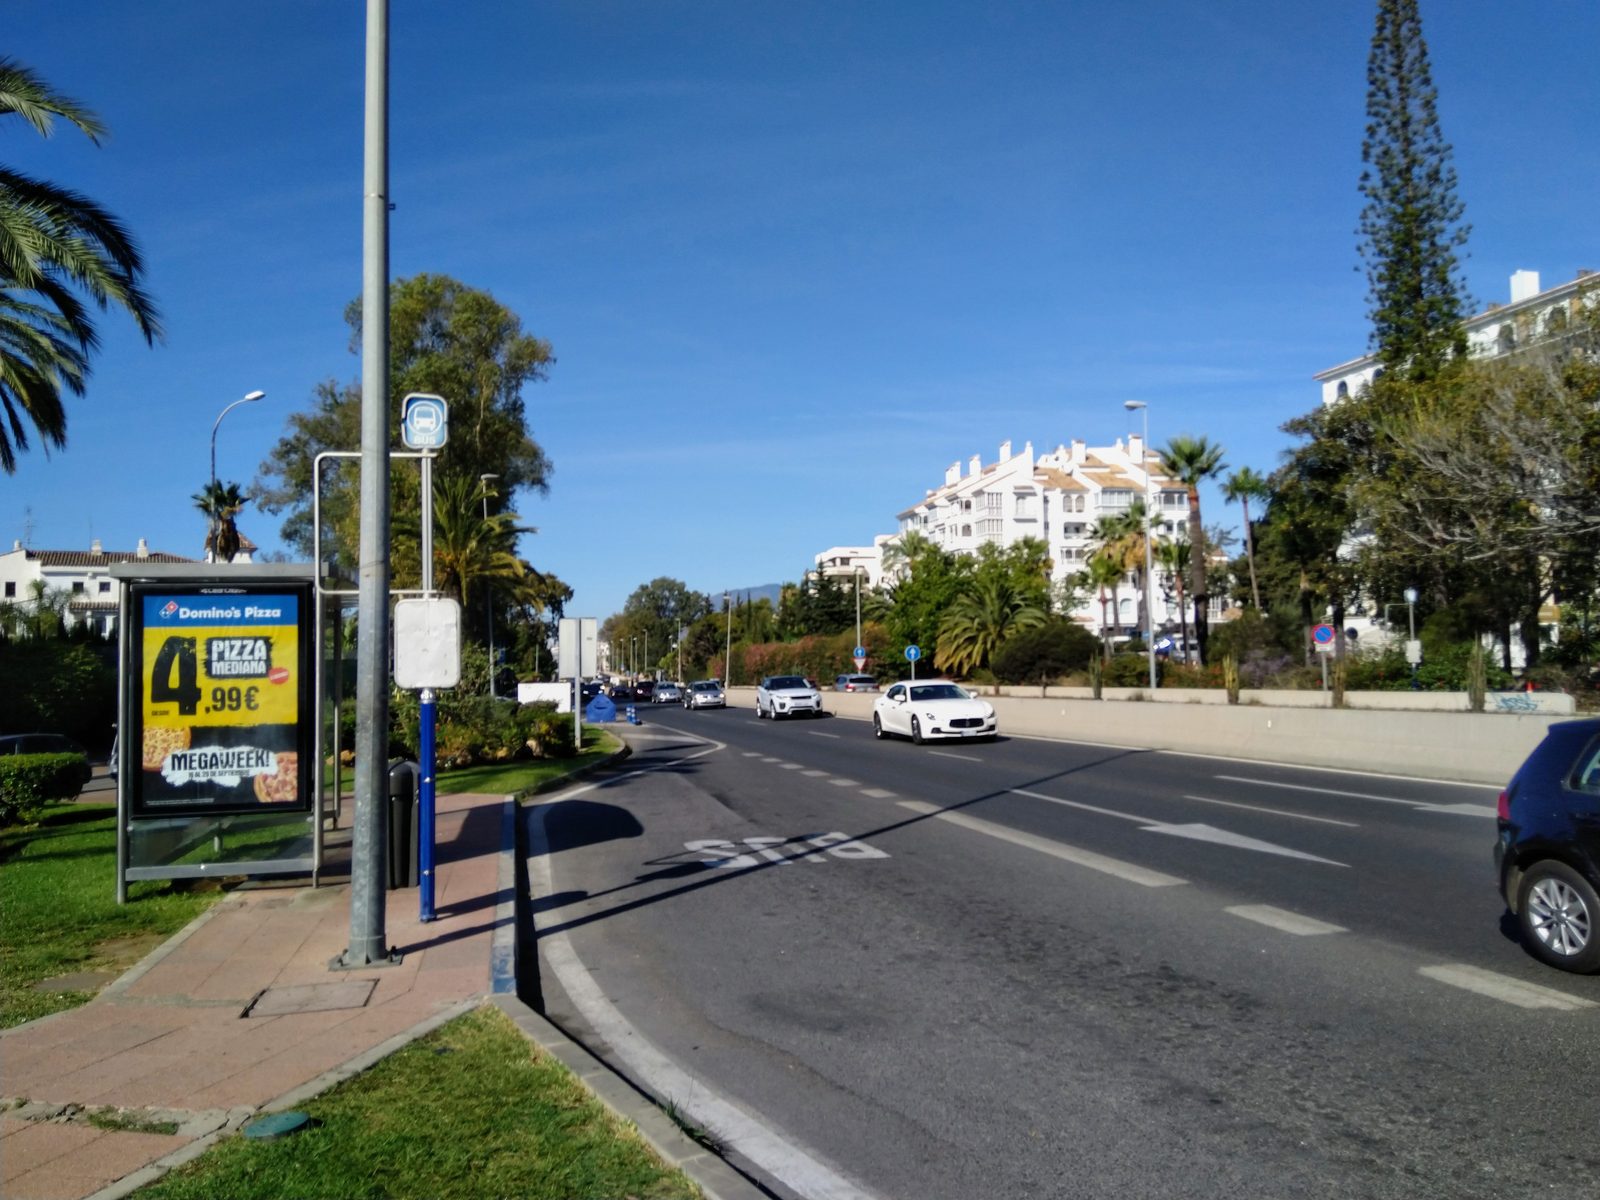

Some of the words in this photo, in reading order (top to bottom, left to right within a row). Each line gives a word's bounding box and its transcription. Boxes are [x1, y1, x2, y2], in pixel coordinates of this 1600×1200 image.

[413, 435, 436, 445] BUS
[178, 606, 242, 619] Domino's
[244, 605, 282, 618] Pizza
[211, 639, 267, 661] PIZZA
[151, 636, 201, 716] 4
[211, 660, 267, 675] MEDIANA
[171, 749, 270, 771] MEGAWEEK!
